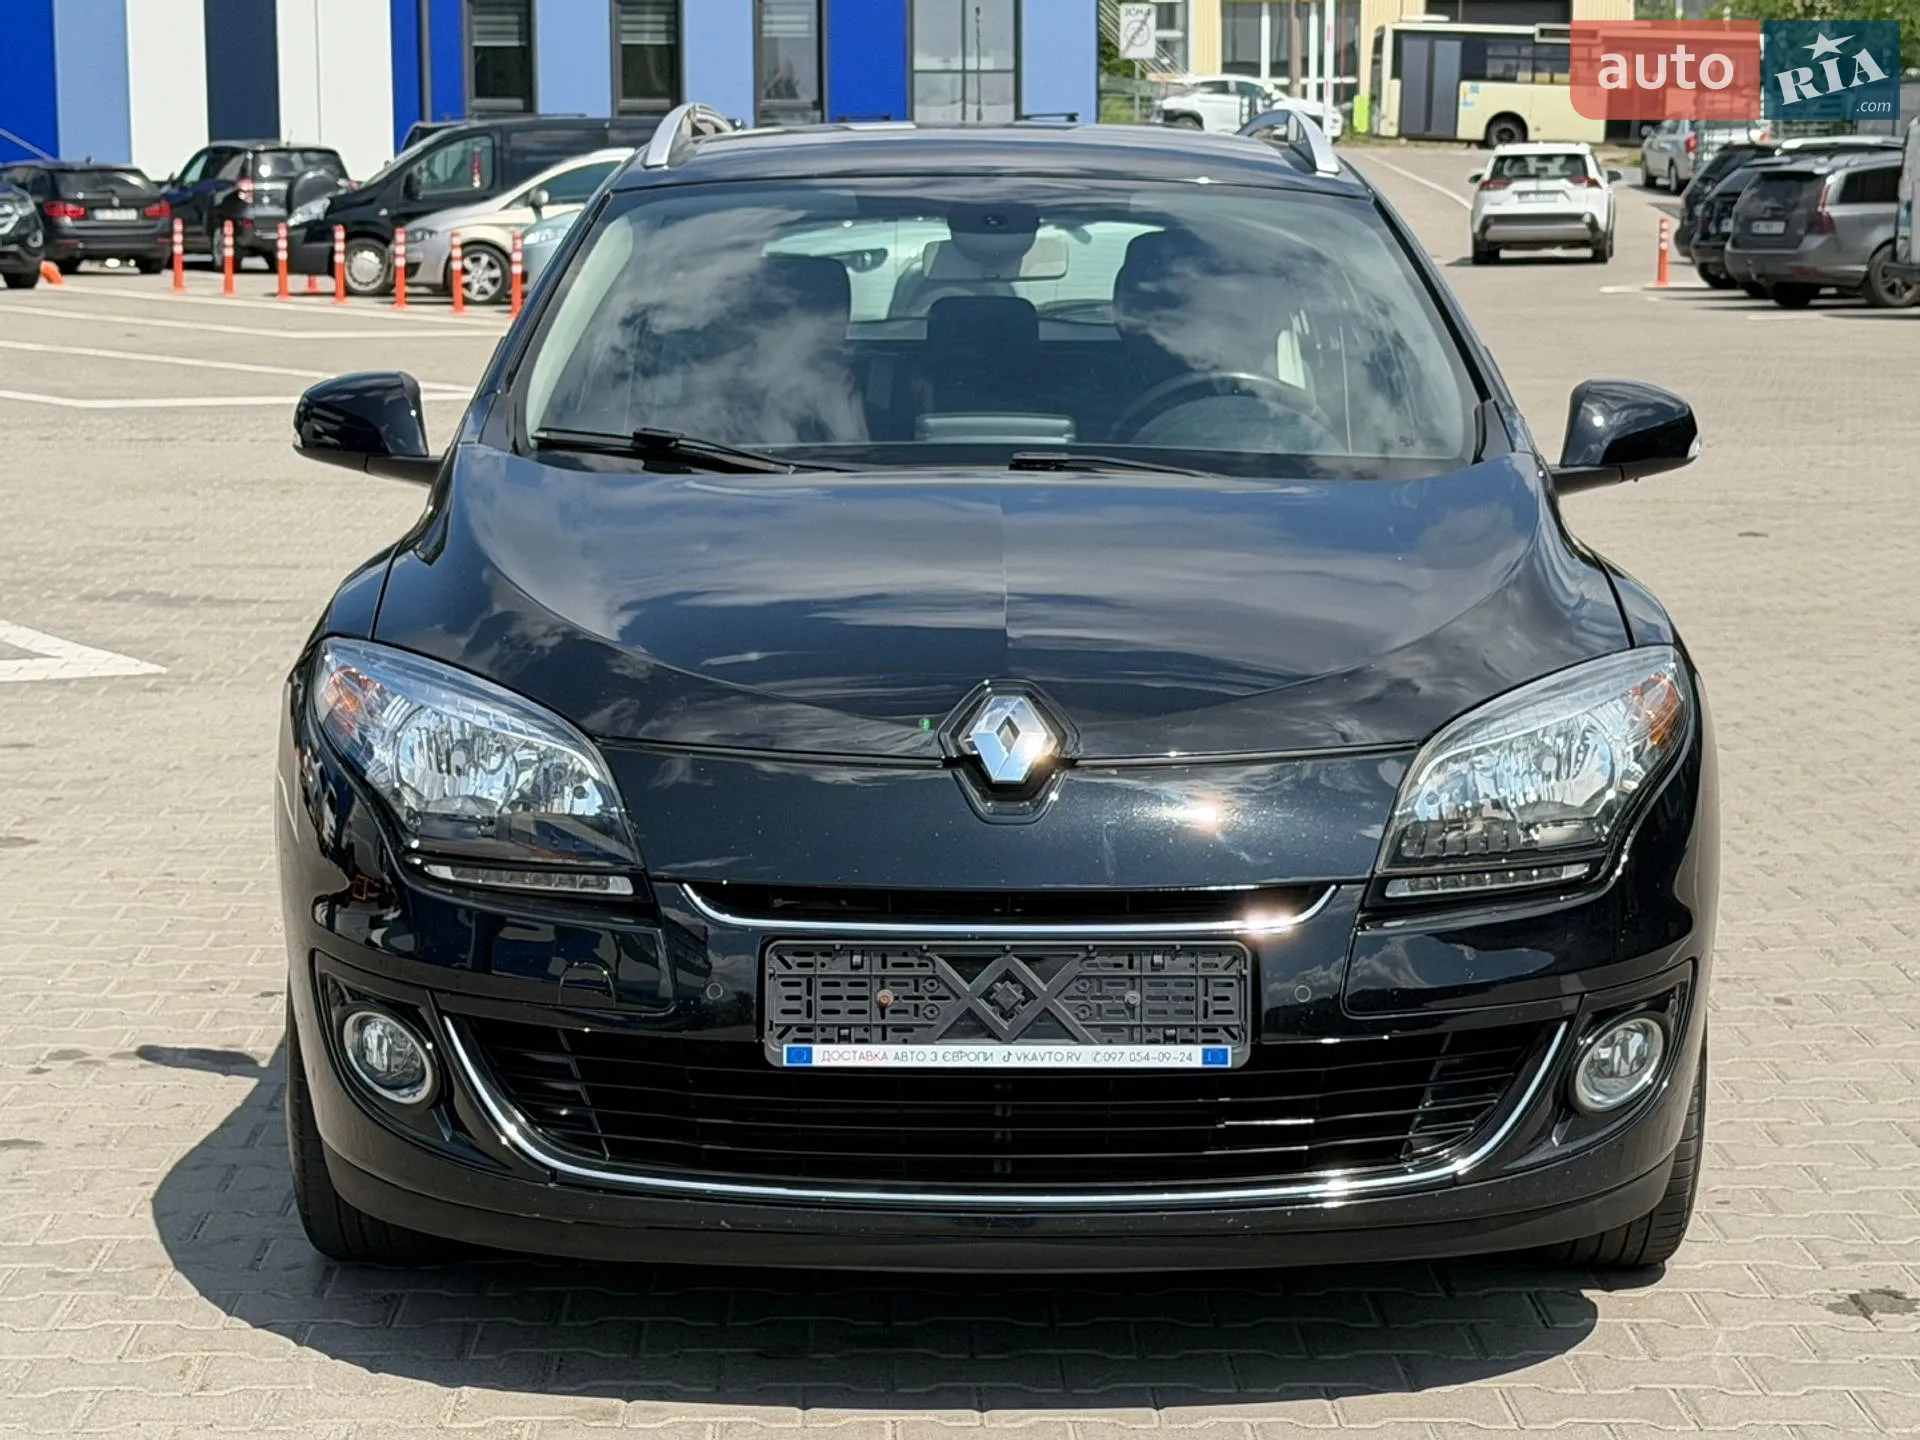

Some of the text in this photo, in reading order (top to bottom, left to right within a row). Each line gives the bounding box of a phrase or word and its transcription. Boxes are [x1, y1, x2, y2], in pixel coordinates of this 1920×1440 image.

[821, 1050, 888, 1062] ДОСТАВКА
[893, 1050, 927, 1062] АВТО
[942, 1050, 994, 1062] ЄВРОПИ
[1103, 1051, 1125, 1062] 097
[1129, 1051, 1193, 1062] 054-09-24
